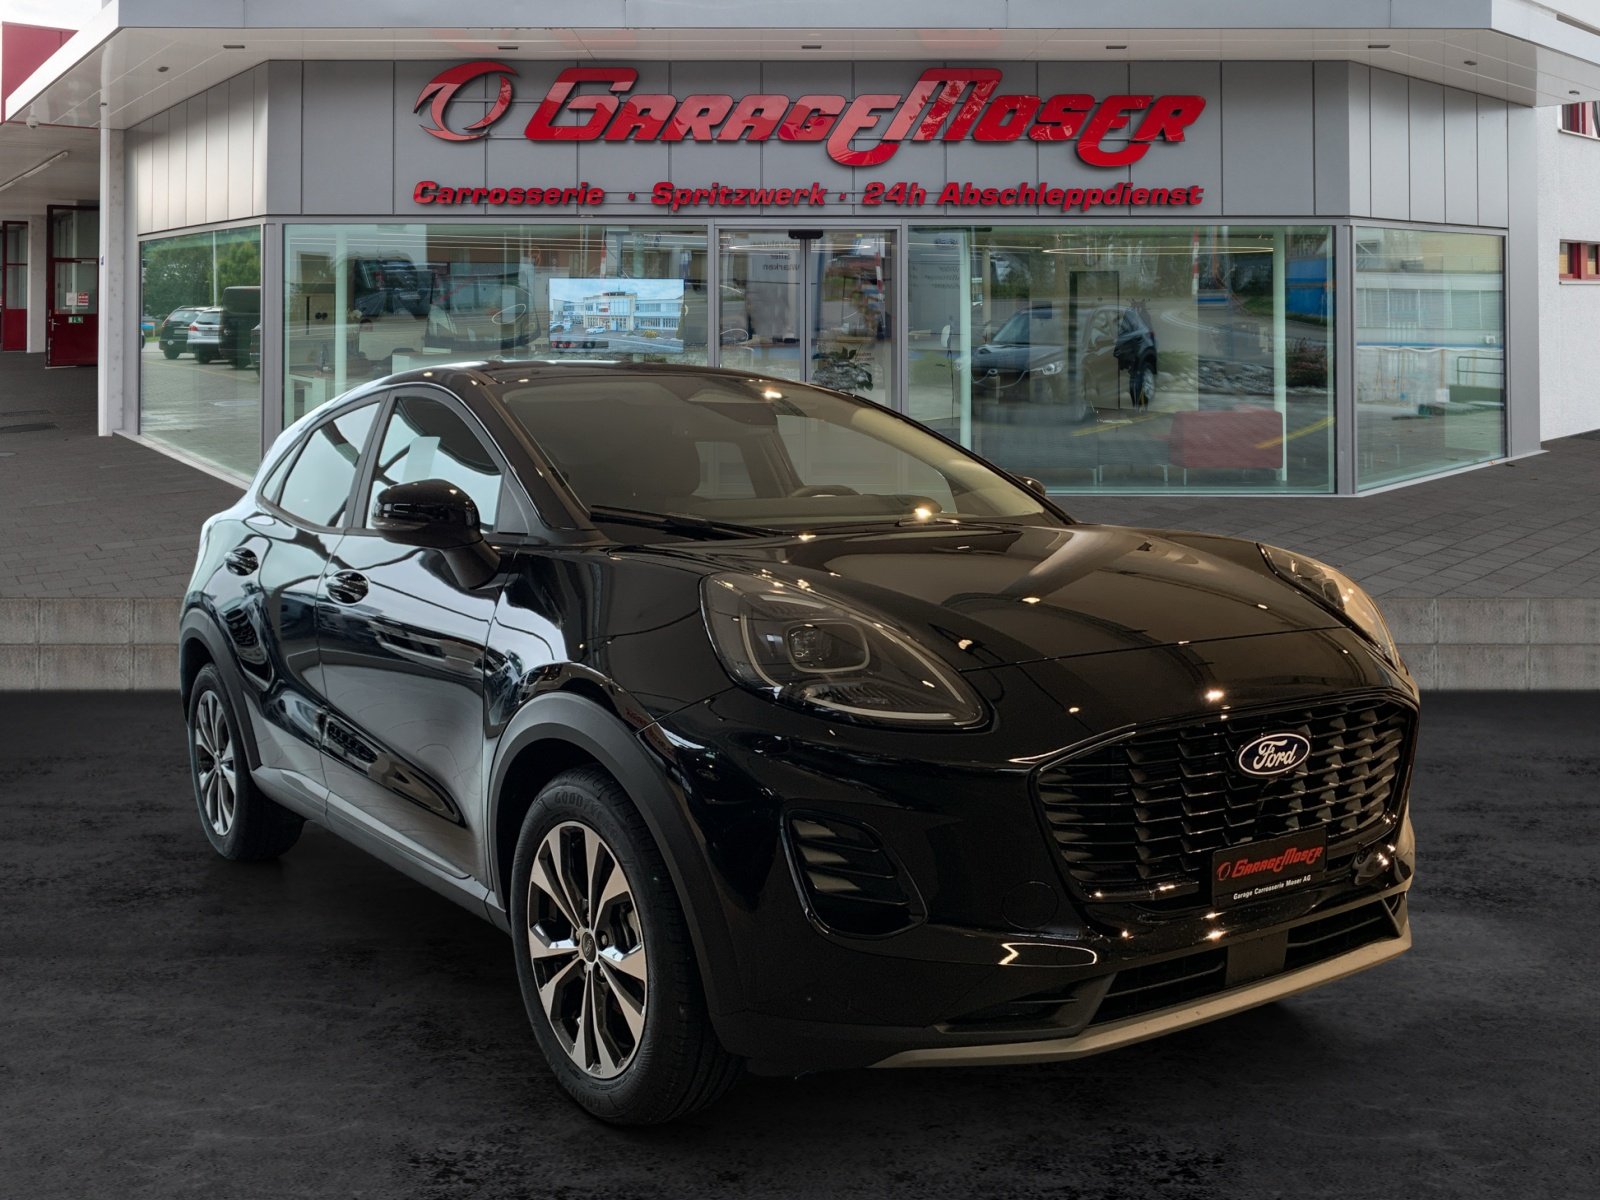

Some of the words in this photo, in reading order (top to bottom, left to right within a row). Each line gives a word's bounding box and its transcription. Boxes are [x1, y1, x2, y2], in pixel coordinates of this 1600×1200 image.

[412, 181, 605, 206] Carrosserie
[651, 181, 826, 211] Spritzwerk
[862, 181, 927, 206] 24h
[937, 181, 1204, 211] Abschleppdienst
[1253, 739, 1298, 769] Ford
[1233, 890, 1253, 900] Garage
[1254, 881, 1285, 895] Carrosserie
[1285, 878, 1302, 887] Moser
[1302, 874, 1312, 883] AG
